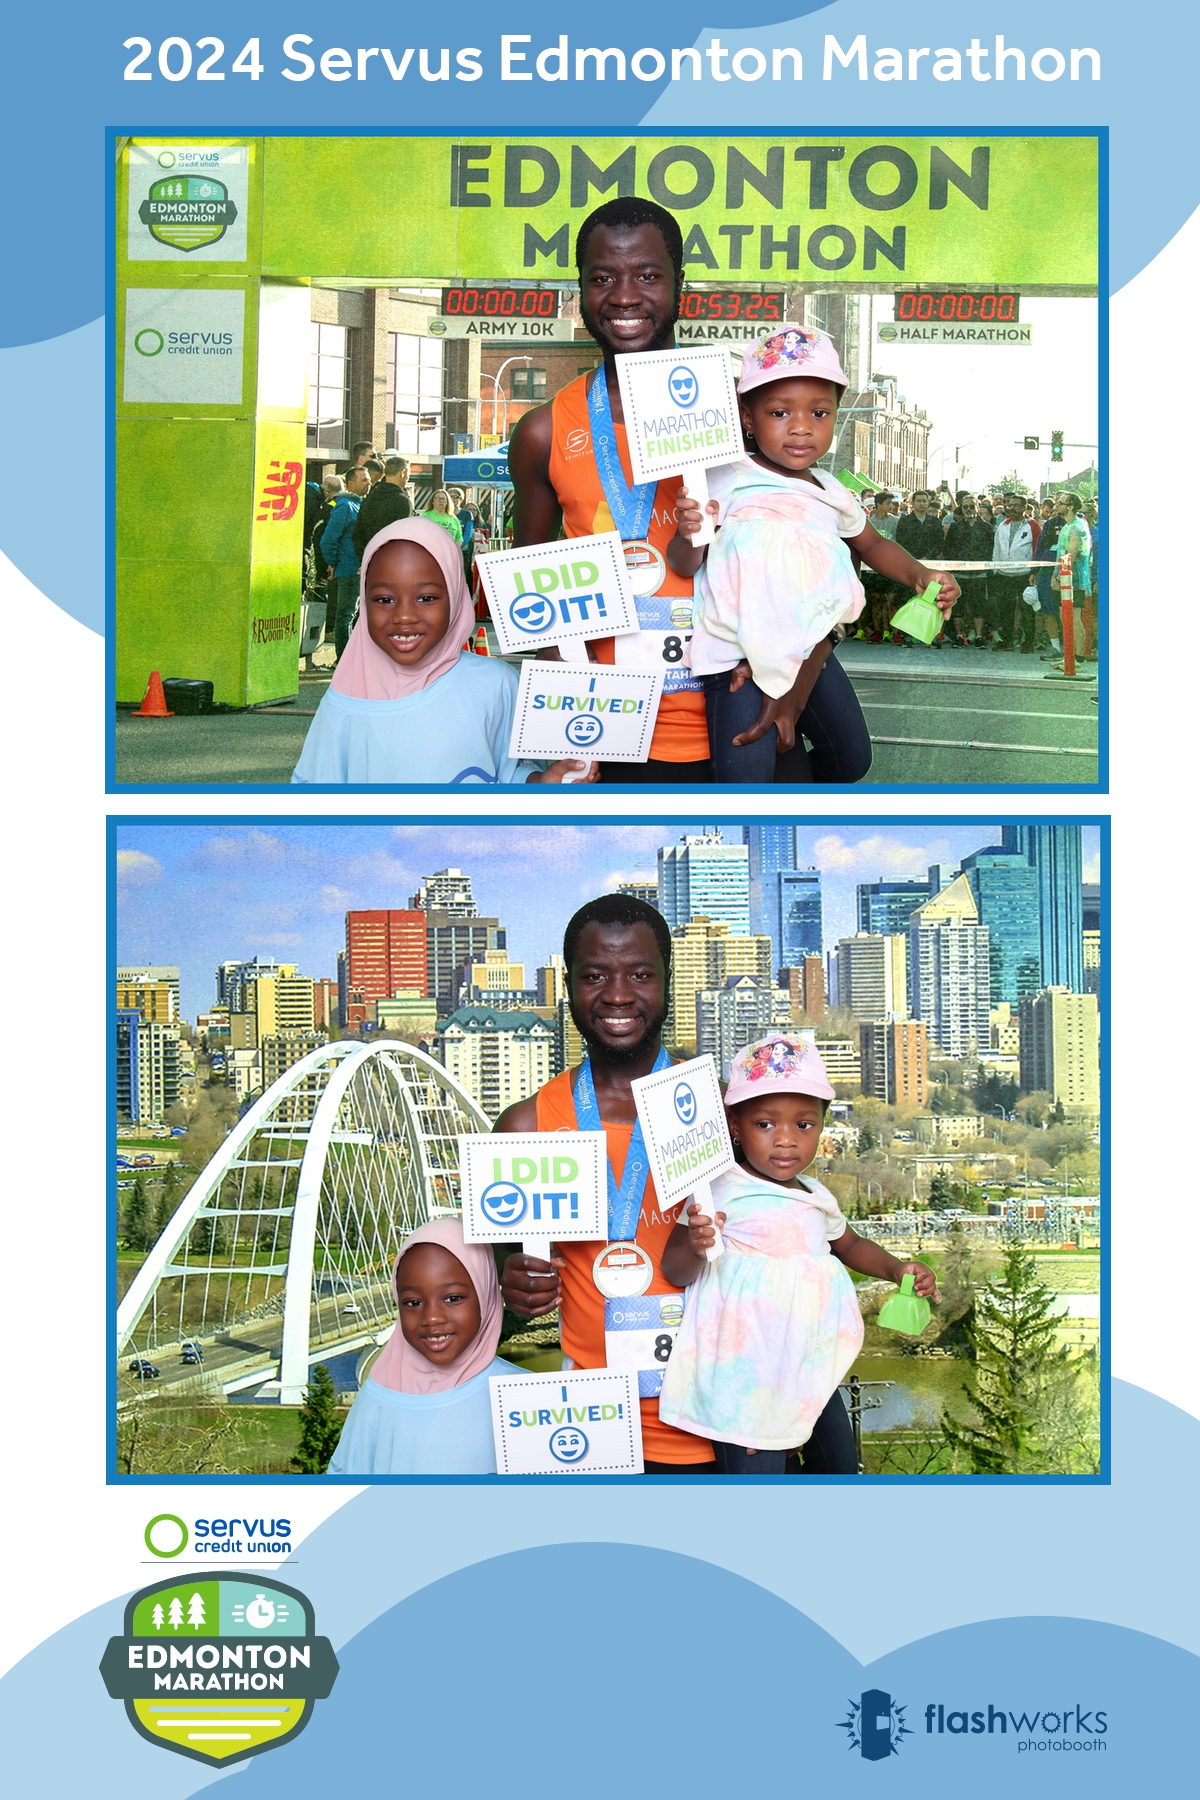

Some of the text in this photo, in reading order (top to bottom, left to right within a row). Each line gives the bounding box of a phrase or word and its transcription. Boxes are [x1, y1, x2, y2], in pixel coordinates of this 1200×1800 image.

[178, 152, 219, 161] servus
[450, 145, 990, 211] EDMONTON
[149, 203, 227, 214] EDMONTON
[160, 214, 215, 222] MARATHON
[523, 222, 906, 271] MATHON
[168, 332, 233, 345] servus
[466, 321, 554, 337] ARMY 10K
[678, 325, 776, 340] MARATHO
[900, 328, 1031, 341] HALF MARATHON
[168, 345, 233, 355] credit union
[643, 408, 727, 439] MARATHON
[646, 426, 730, 458] FINISHER!
[602, 445, 627, 516] servus credit union
[513, 560, 599, 594] I DID
[558, 592, 608, 623] IT!
[589, 678, 596, 692] I
[532, 694, 644, 714] SURVIVED!
[660, 1117, 720, 1163] MARATHON
[493, 1156, 579, 1184] I DID
[665, 1136, 724, 1182] FINISHER!
[627, 1172, 638, 1200] servus
[532, 1192, 579, 1220] IT!
[622, 1201, 632, 1225] credit
[561, 1386, 568, 1402] I
[509, 1403, 623, 1428] SURVIVED!
